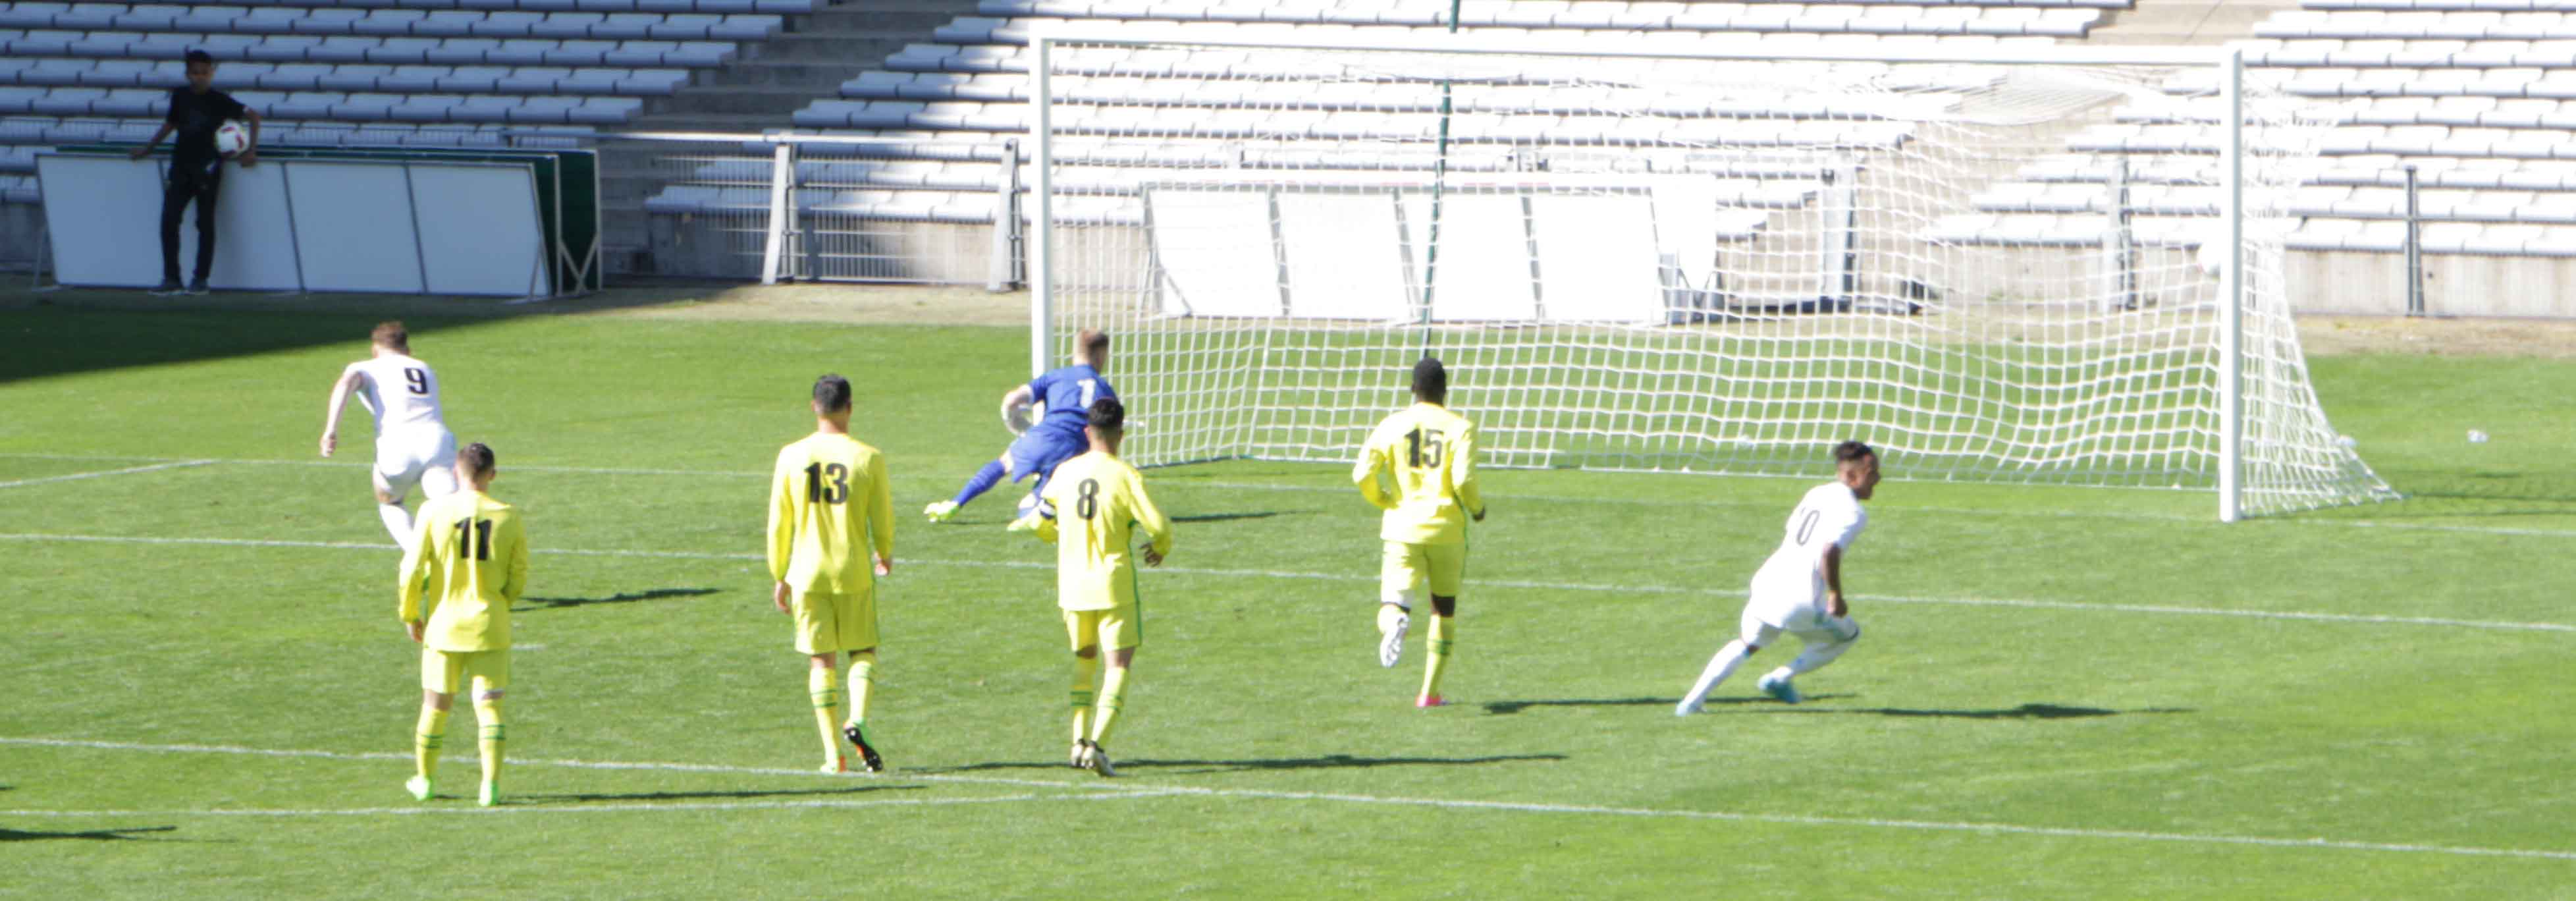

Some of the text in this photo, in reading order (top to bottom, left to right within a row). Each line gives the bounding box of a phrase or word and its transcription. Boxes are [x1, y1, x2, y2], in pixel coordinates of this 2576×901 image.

[404, 368, 428, 395] 9
[1077, 379, 1096, 408] 1
[1404, 428, 1444, 468] 15
[805, 462, 848, 505] 13
[1077, 478, 1100, 519] 8
[454, 516, 492, 560] 11
[1796, 506, 1820, 547] 0
